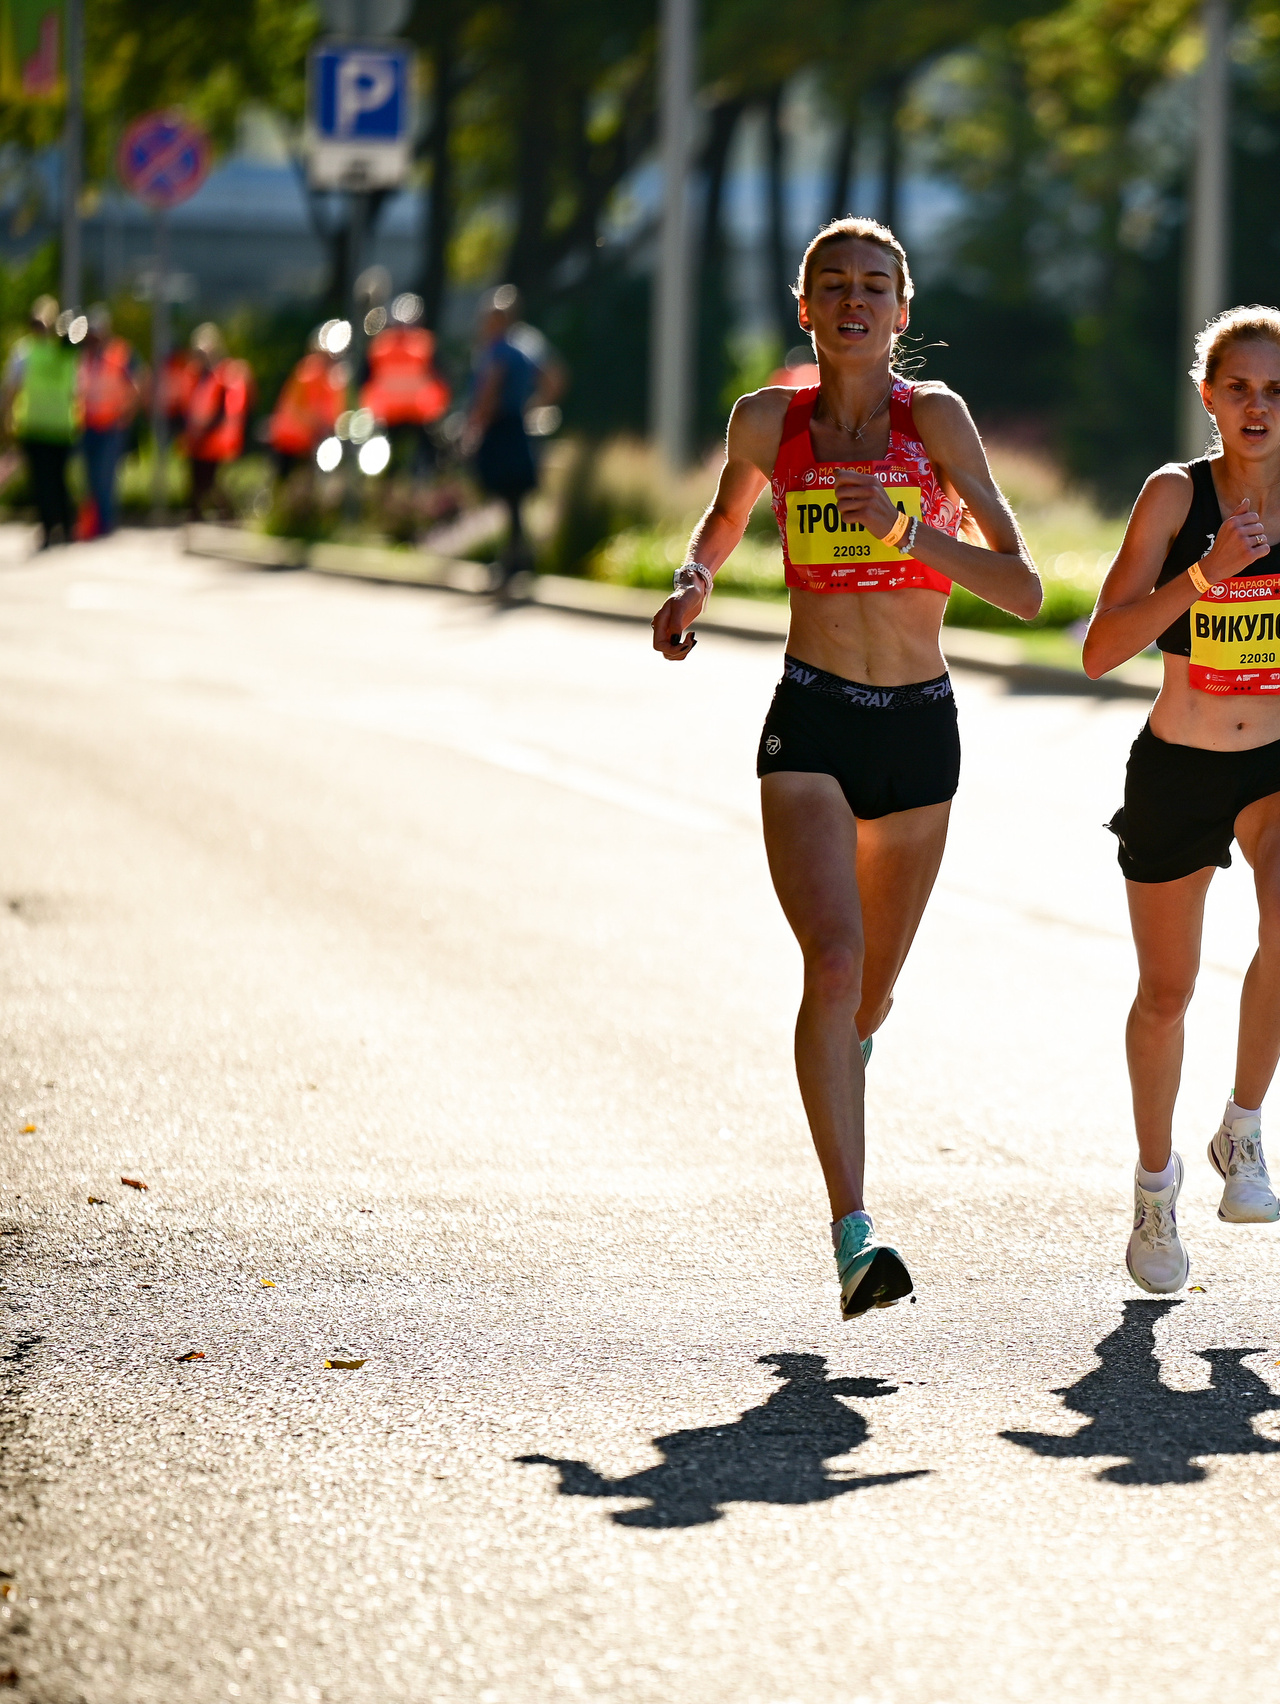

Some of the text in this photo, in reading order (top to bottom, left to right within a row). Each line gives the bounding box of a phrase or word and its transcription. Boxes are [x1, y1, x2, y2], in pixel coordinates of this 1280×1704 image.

[336, 54, 396, 138] P
[833, 545, 871, 557] 22033
[1229, 578, 1280, 590] МАРАФОН
[1229, 587, 1273, 599] МОСКВА
[1239, 652, 1276, 664] 22030
[842, 686, 895, 708] RAY
